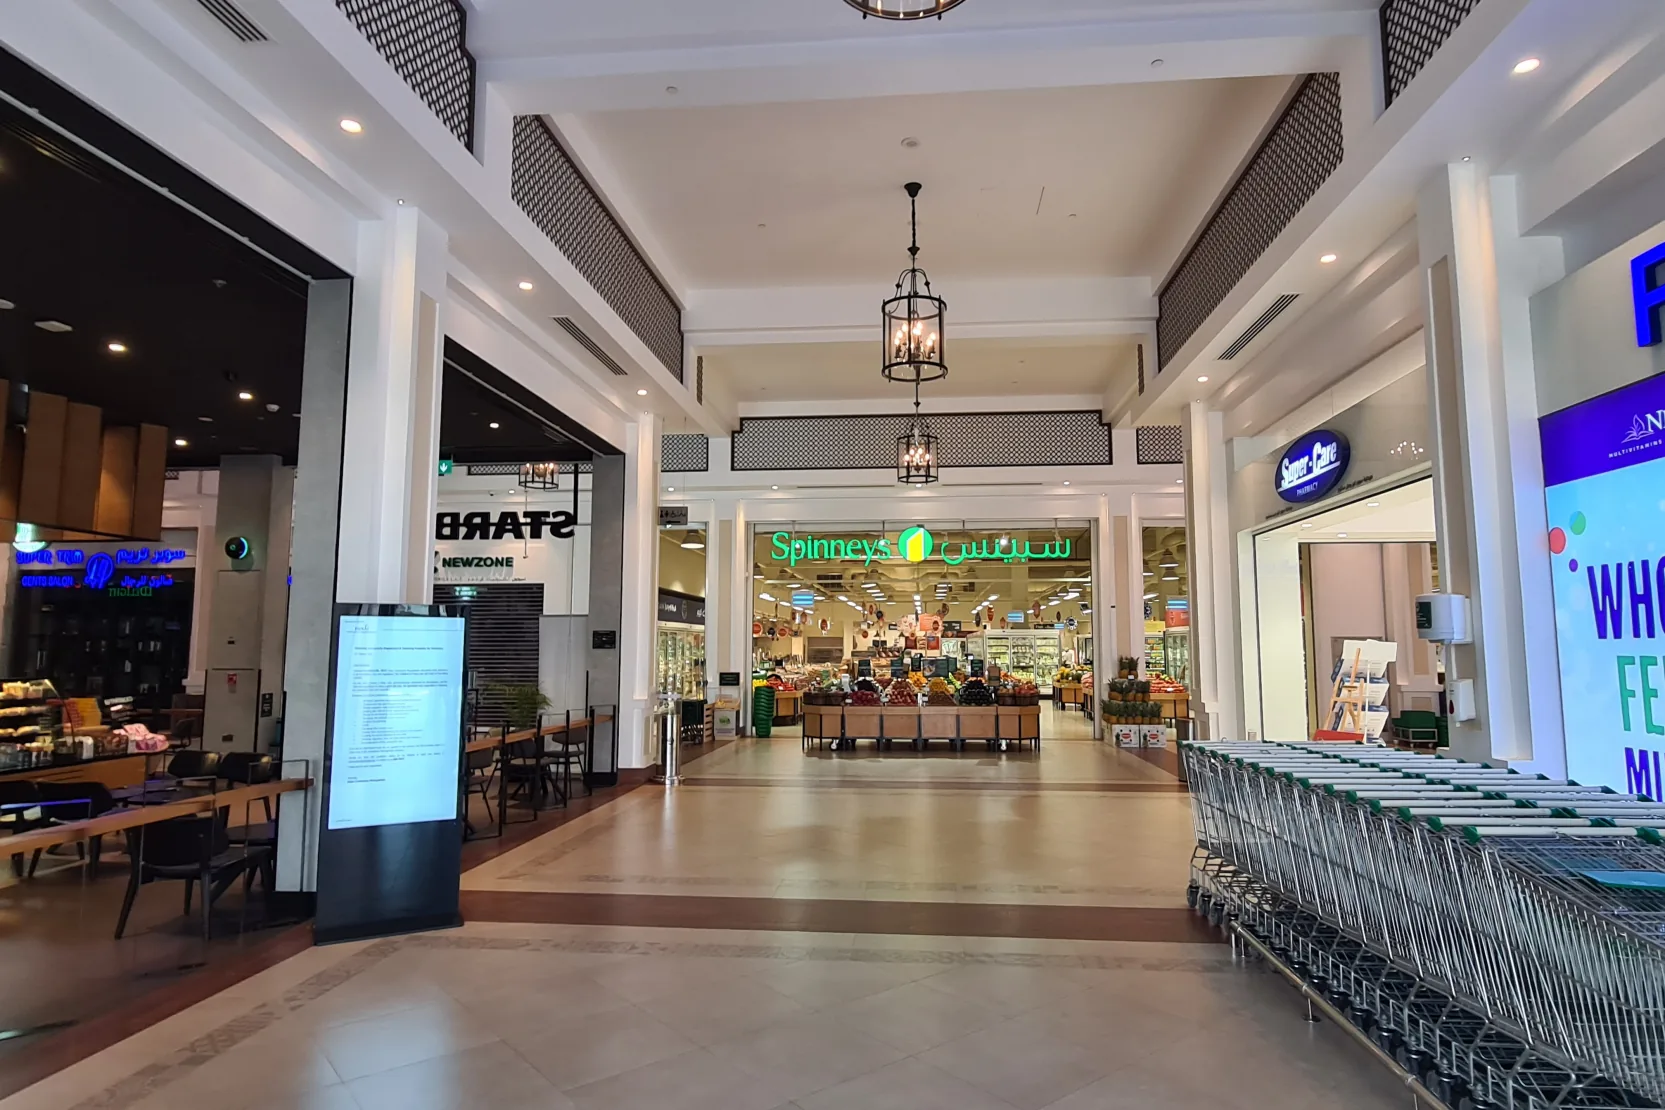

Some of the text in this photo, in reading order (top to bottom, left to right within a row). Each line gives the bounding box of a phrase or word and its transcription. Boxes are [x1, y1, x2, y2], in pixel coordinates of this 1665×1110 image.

[1608, 438, 1662, 459] MULTIVITAMINS
[1296, 481, 1319, 496] PHARMACY
[442, 557, 514, 568] NEWZONE
[771, 531, 891, 567] Spinneys
[1617, 655, 1665, 735] FE
[1625, 747, 1665, 804] MI
